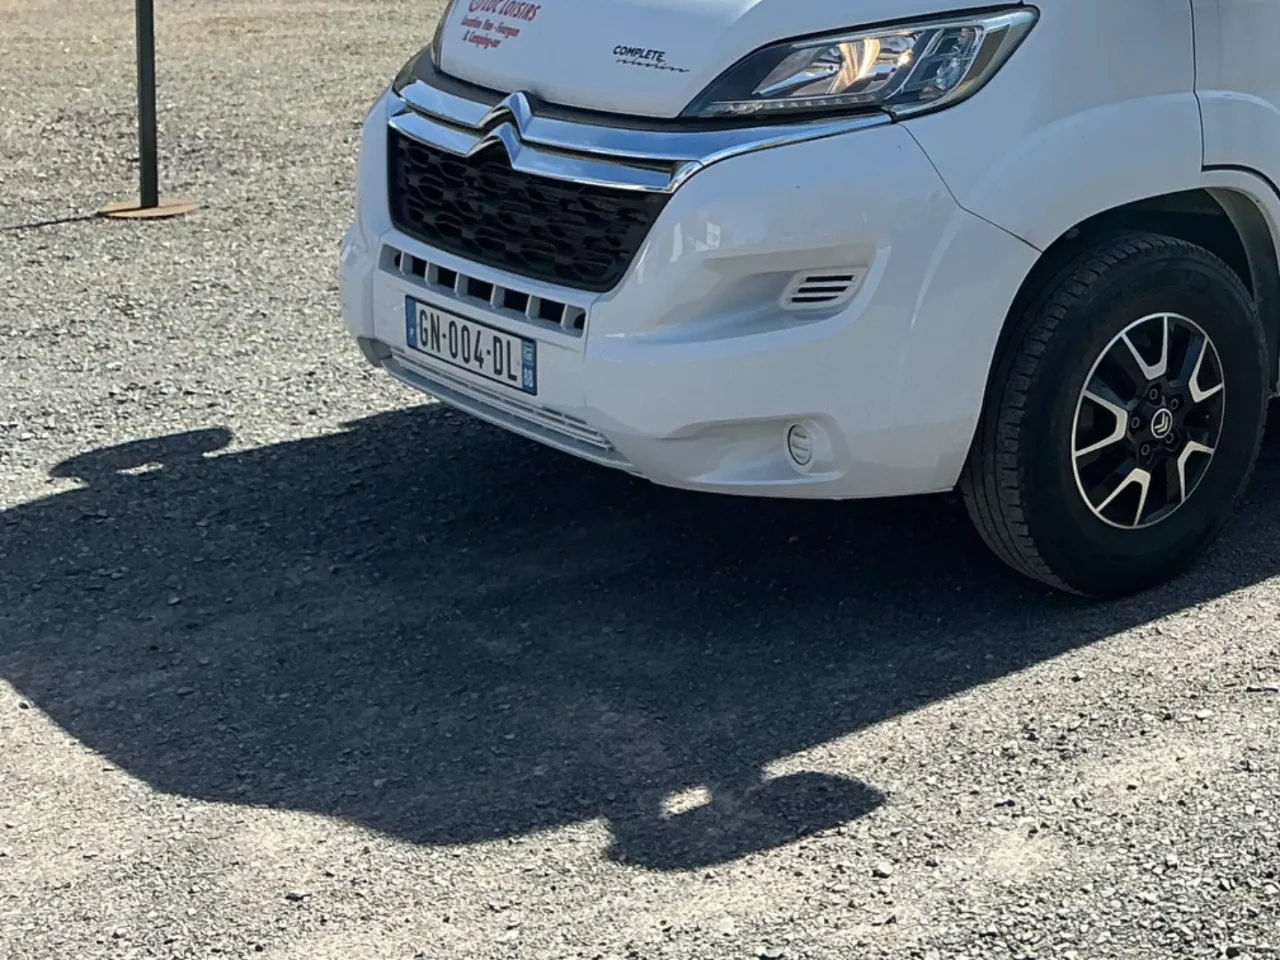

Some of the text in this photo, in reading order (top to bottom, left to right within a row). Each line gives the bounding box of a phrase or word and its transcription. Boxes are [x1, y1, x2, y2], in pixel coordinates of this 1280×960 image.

[498, 0, 541, 21] LOISIRS
[612, 45, 665, 62] COMPLETE
[420, 309, 518, 381] GN-004-DL
